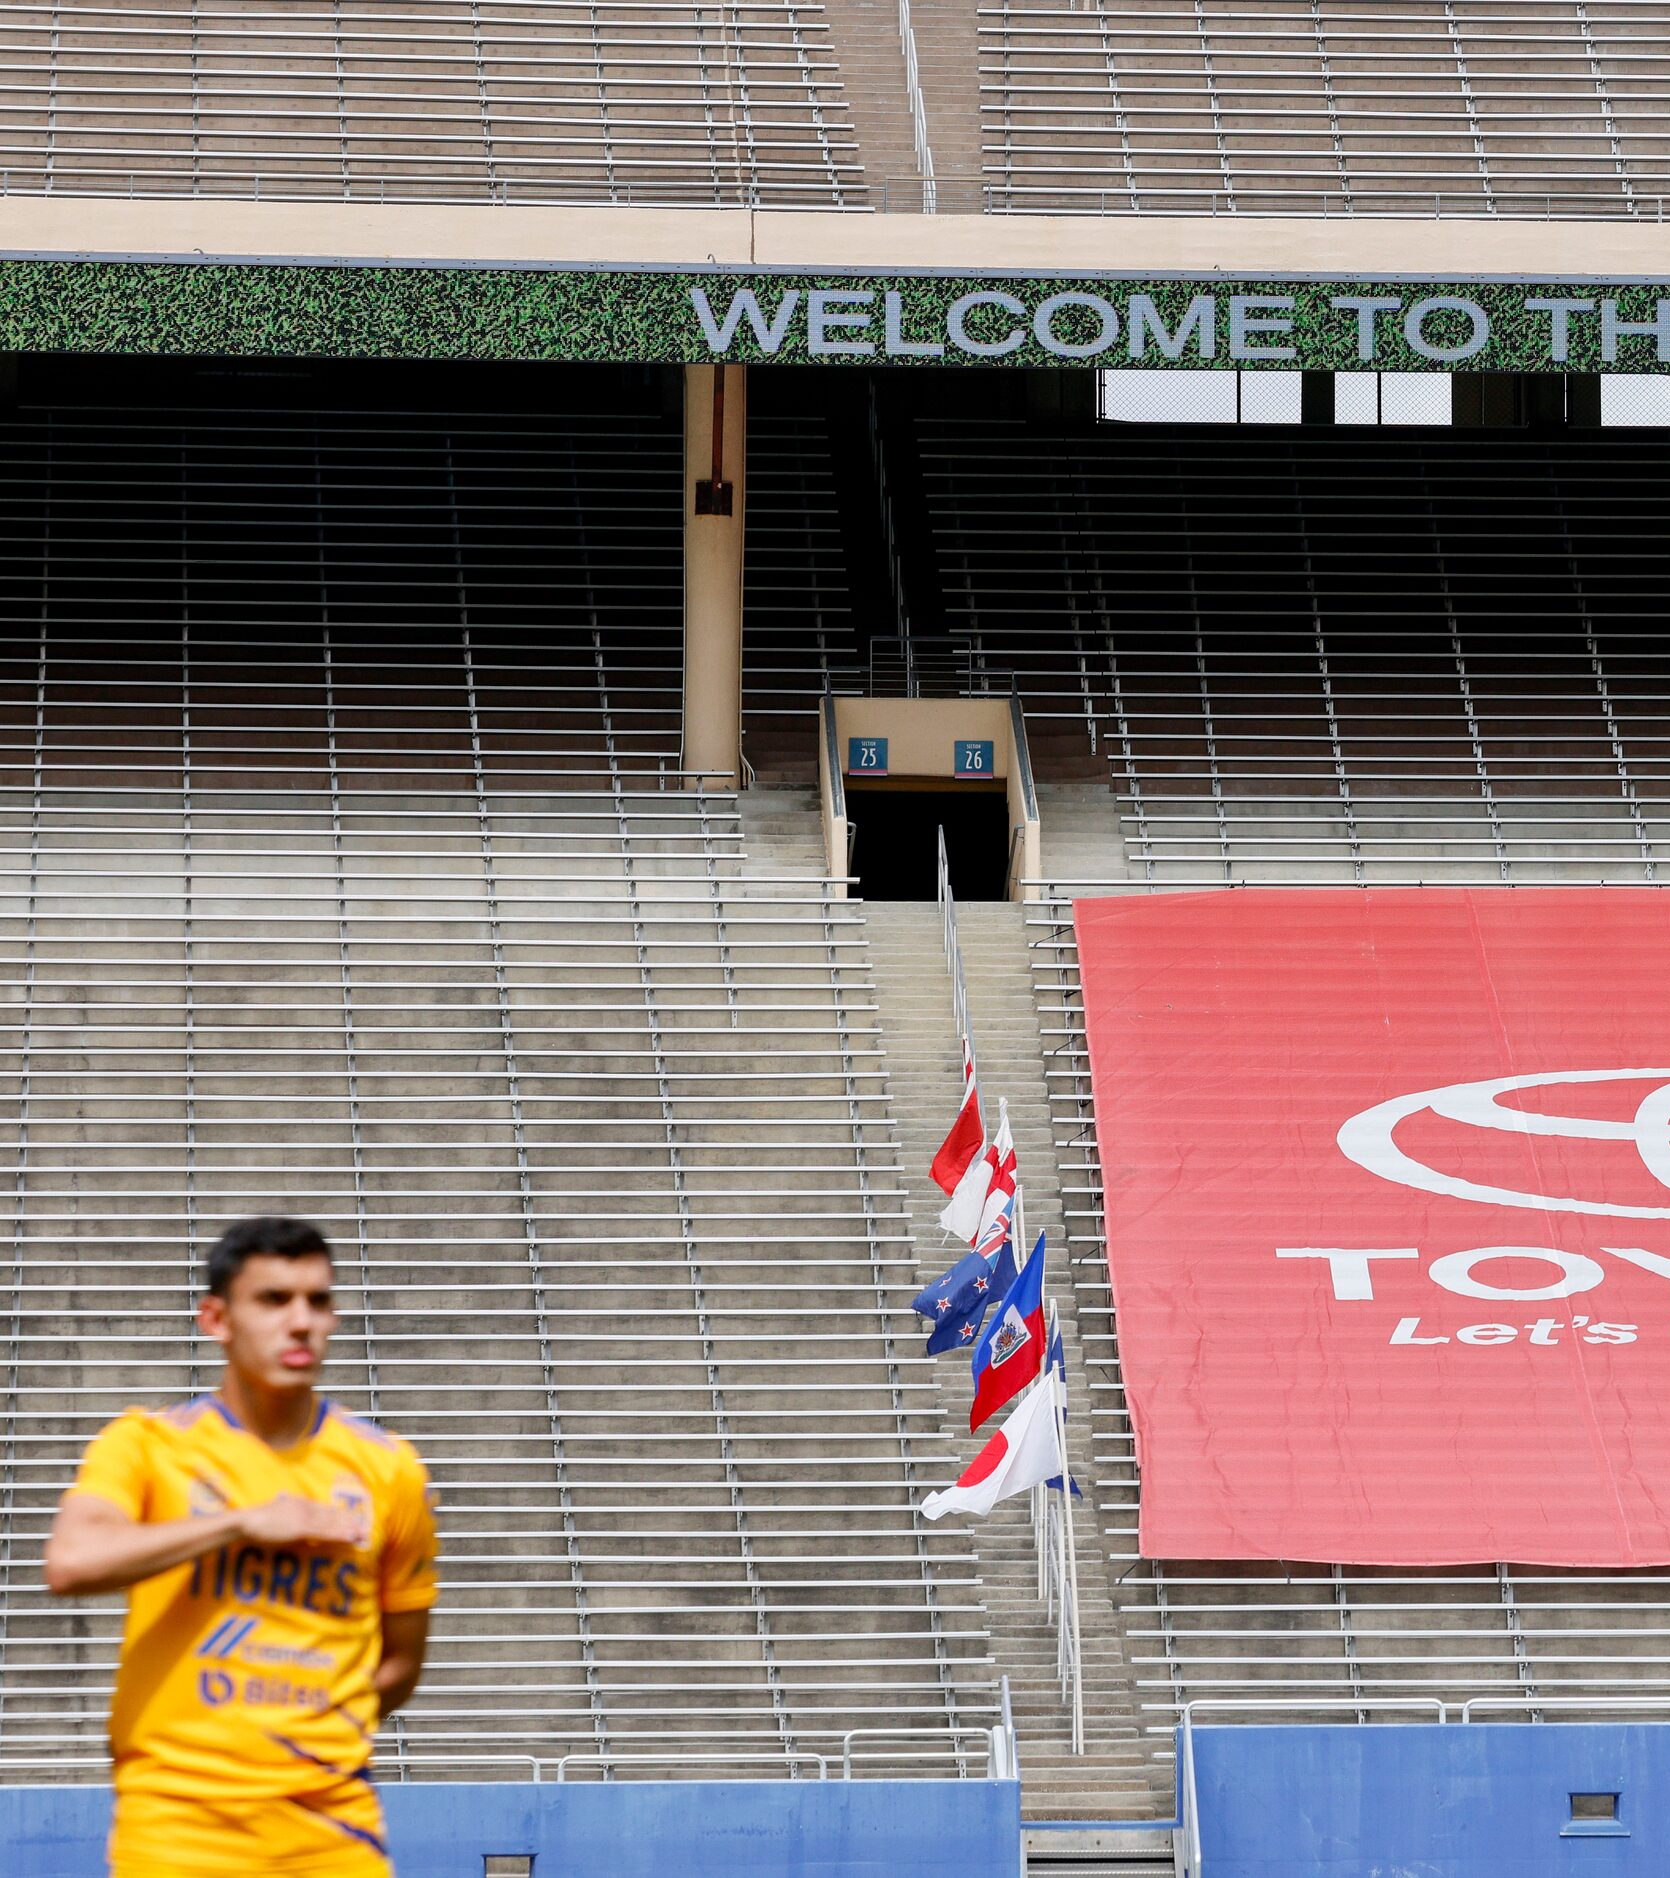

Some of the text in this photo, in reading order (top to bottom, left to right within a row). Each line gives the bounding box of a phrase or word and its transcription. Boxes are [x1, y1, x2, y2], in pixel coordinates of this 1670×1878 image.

[691, 287, 1296, 360] WELCOME
[1330, 296, 1490, 361] TO
[861, 748, 877, 767] 25
[965, 751, 983, 770] 26
[1389, 1315, 1639, 1346] Let's
